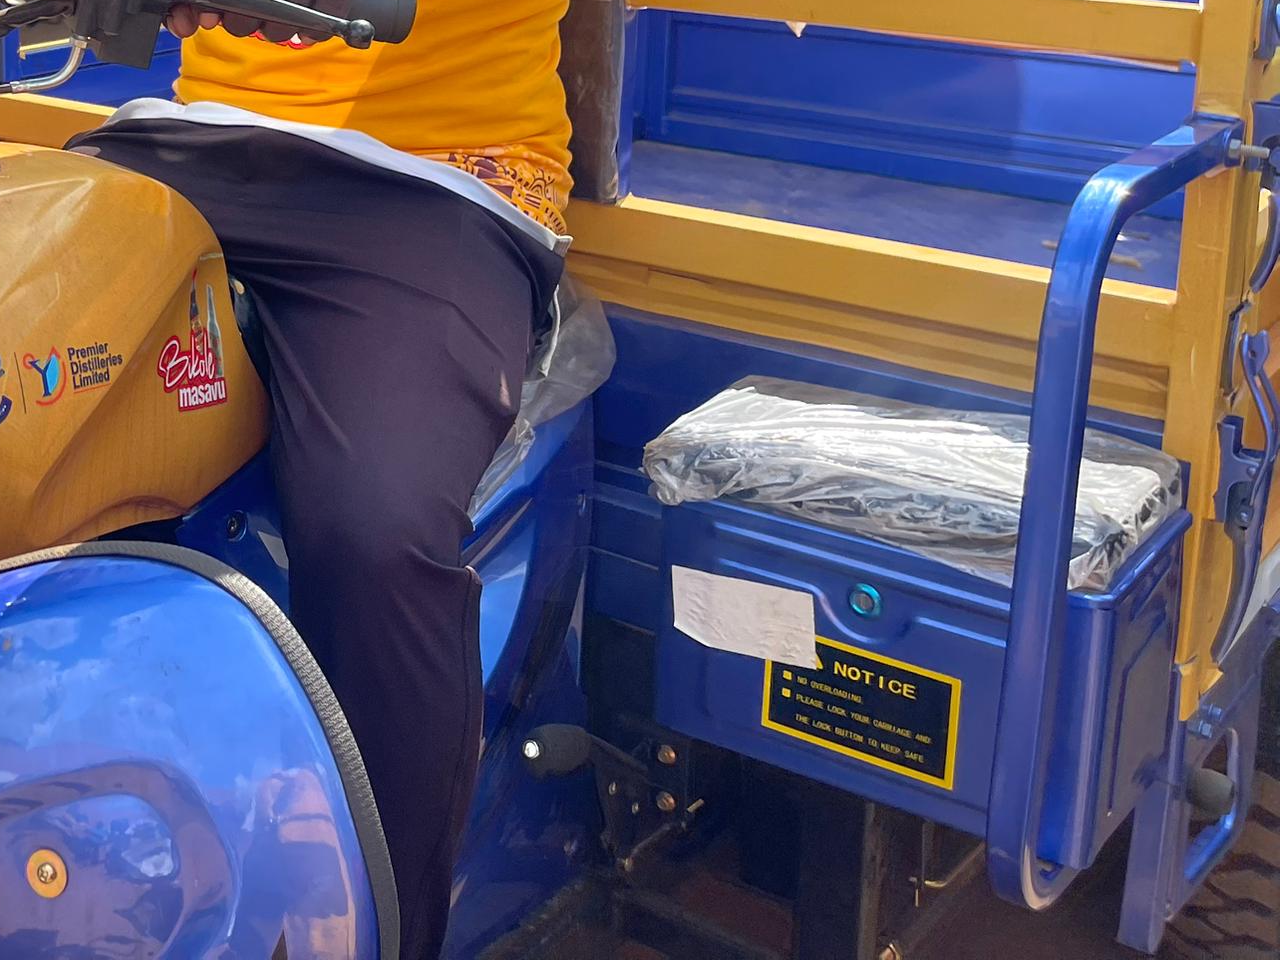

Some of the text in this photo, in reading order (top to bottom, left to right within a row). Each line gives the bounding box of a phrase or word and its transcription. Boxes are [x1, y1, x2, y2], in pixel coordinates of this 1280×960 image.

[67, 342, 109, 361] Premier
[70, 353, 123, 376] Distilleries
[72, 368, 111, 390] Limited
[179, 380, 226, 408] masavu
[797, 676, 808, 685] NO
[833, 661, 917, 700] NOTICE
[795, 693, 825, 710] PLEASE
[827, 704, 847, 718] LOCK
[850, 712, 870, 724] YOUR
[915, 733, 932, 745] AND
[795, 713, 810, 725] THE
[812, 720, 832, 732] LOCK
[834, 726, 864, 743] BUTTON
[868, 737, 878, 748] TO
[880, 742, 901, 754] KEEP
